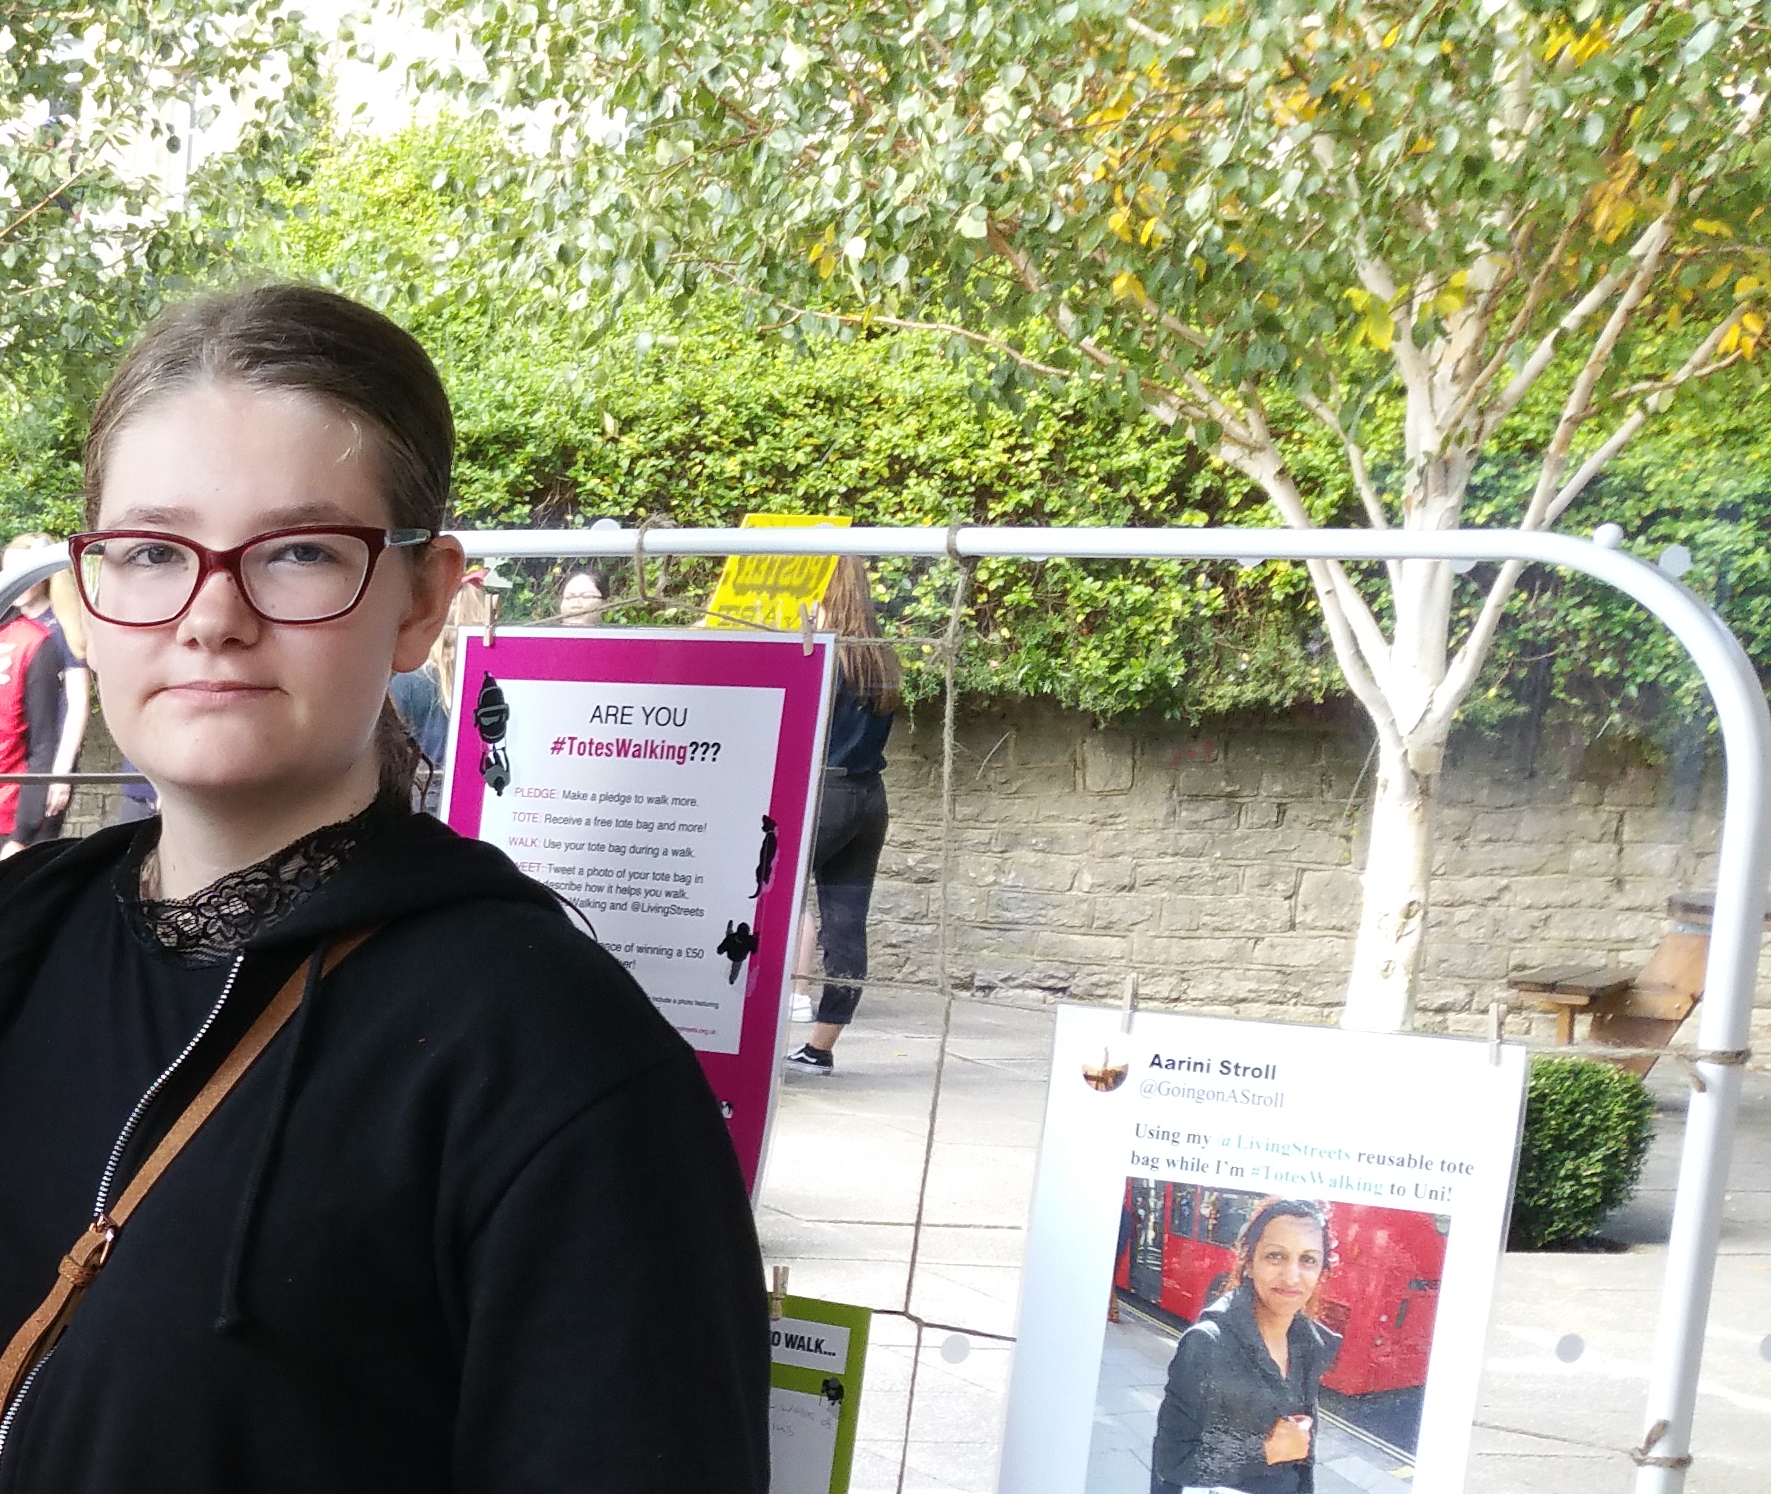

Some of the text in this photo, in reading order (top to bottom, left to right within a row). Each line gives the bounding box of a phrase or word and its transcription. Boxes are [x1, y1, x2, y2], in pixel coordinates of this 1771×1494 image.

[589, 704, 688, 728] ARE YOU
[550, 736, 721, 766] #TotesWalking???
[1149, 1053, 1277, 1081] Aarini Stroll
[1139, 1078, 1285, 1108] @GoingonAStroll
[1134, 1122, 1181, 1146] Using
[1186, 1131, 1212, 1149] my
[1357, 1151, 1434, 1171] reusable
[1440, 1157, 1475, 1176] tote
[1130, 1150, 1160, 1171] bag
[1165, 1155, 1210, 1174] while
[1215, 1159, 1245, 1178] I'm
[1390, 1182, 1407, 1197] to
[1414, 1182, 1453, 1202] Uni!
[784, 1332, 837, 1357] WALK...
